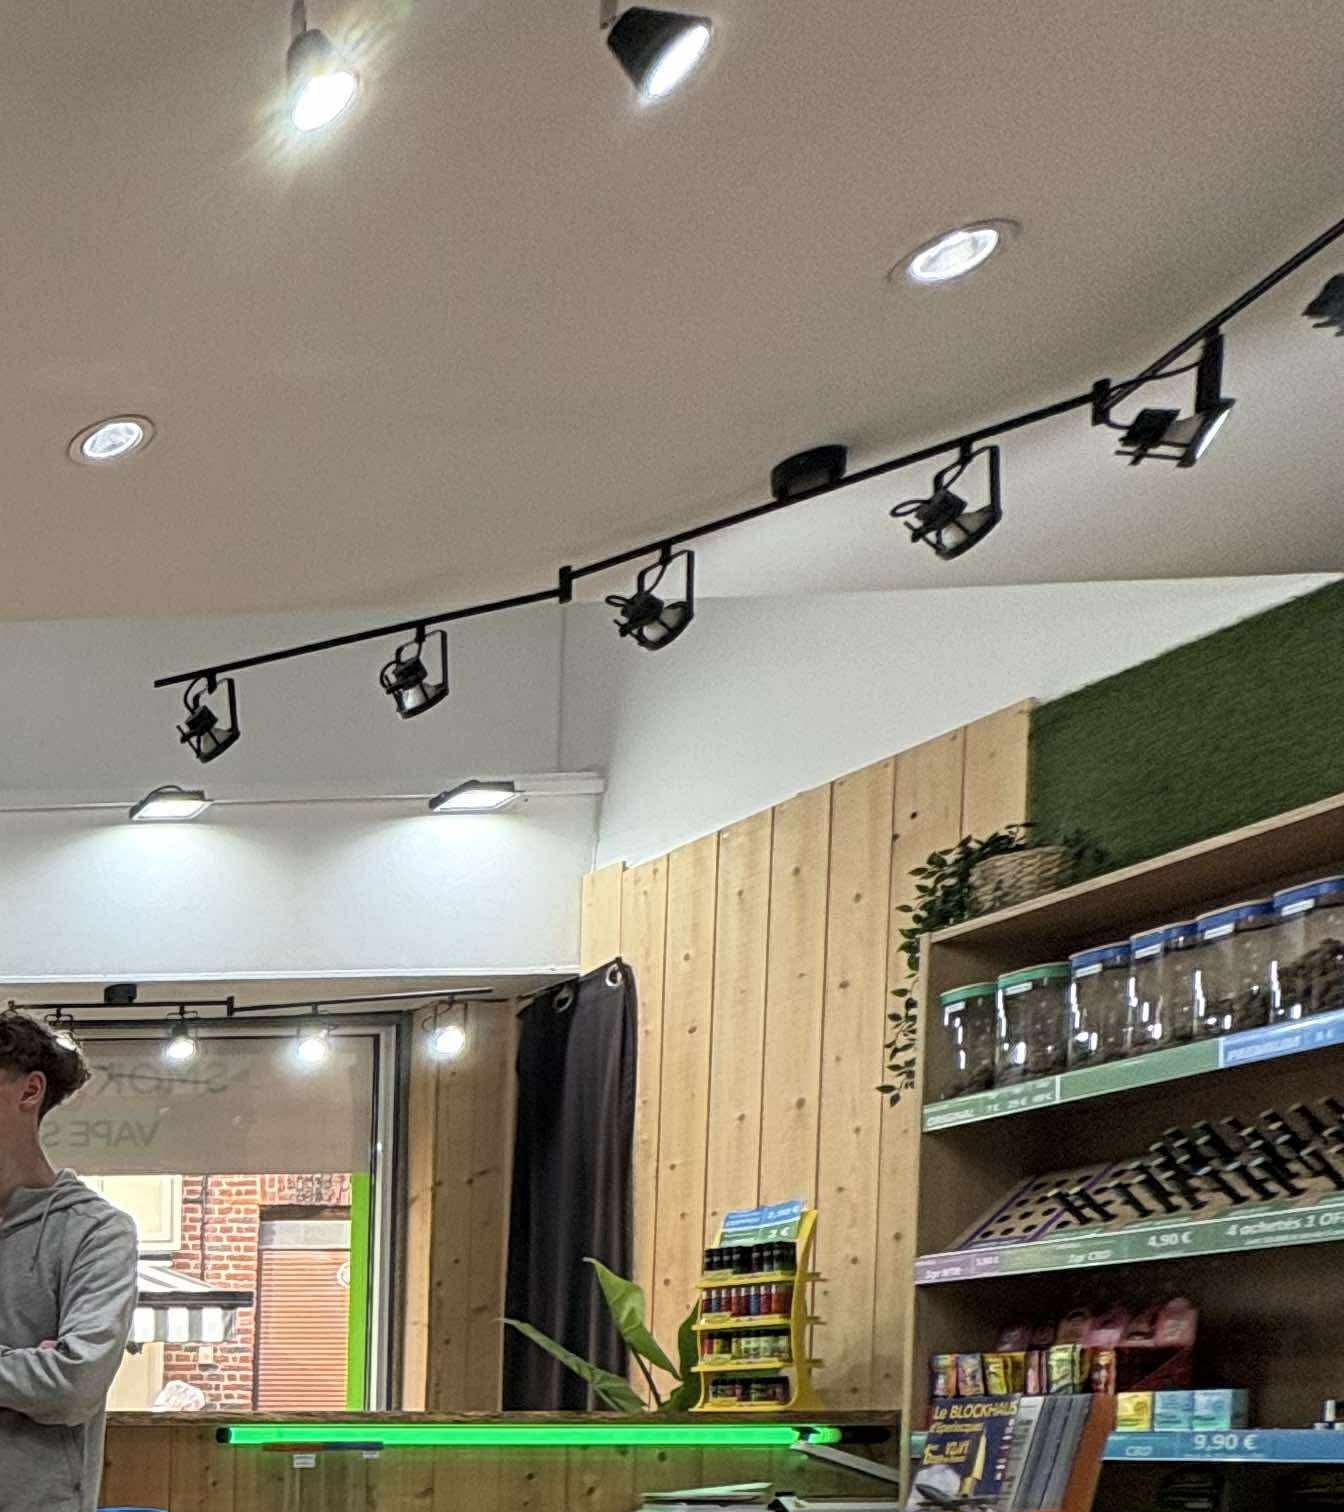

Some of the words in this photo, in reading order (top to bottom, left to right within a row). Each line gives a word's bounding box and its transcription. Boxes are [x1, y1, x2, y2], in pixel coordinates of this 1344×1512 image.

[1181, 1231, 1193, 1245] €
[933, 1406, 948, 1420] Le
[1244, 1433, 1259, 1450] €
